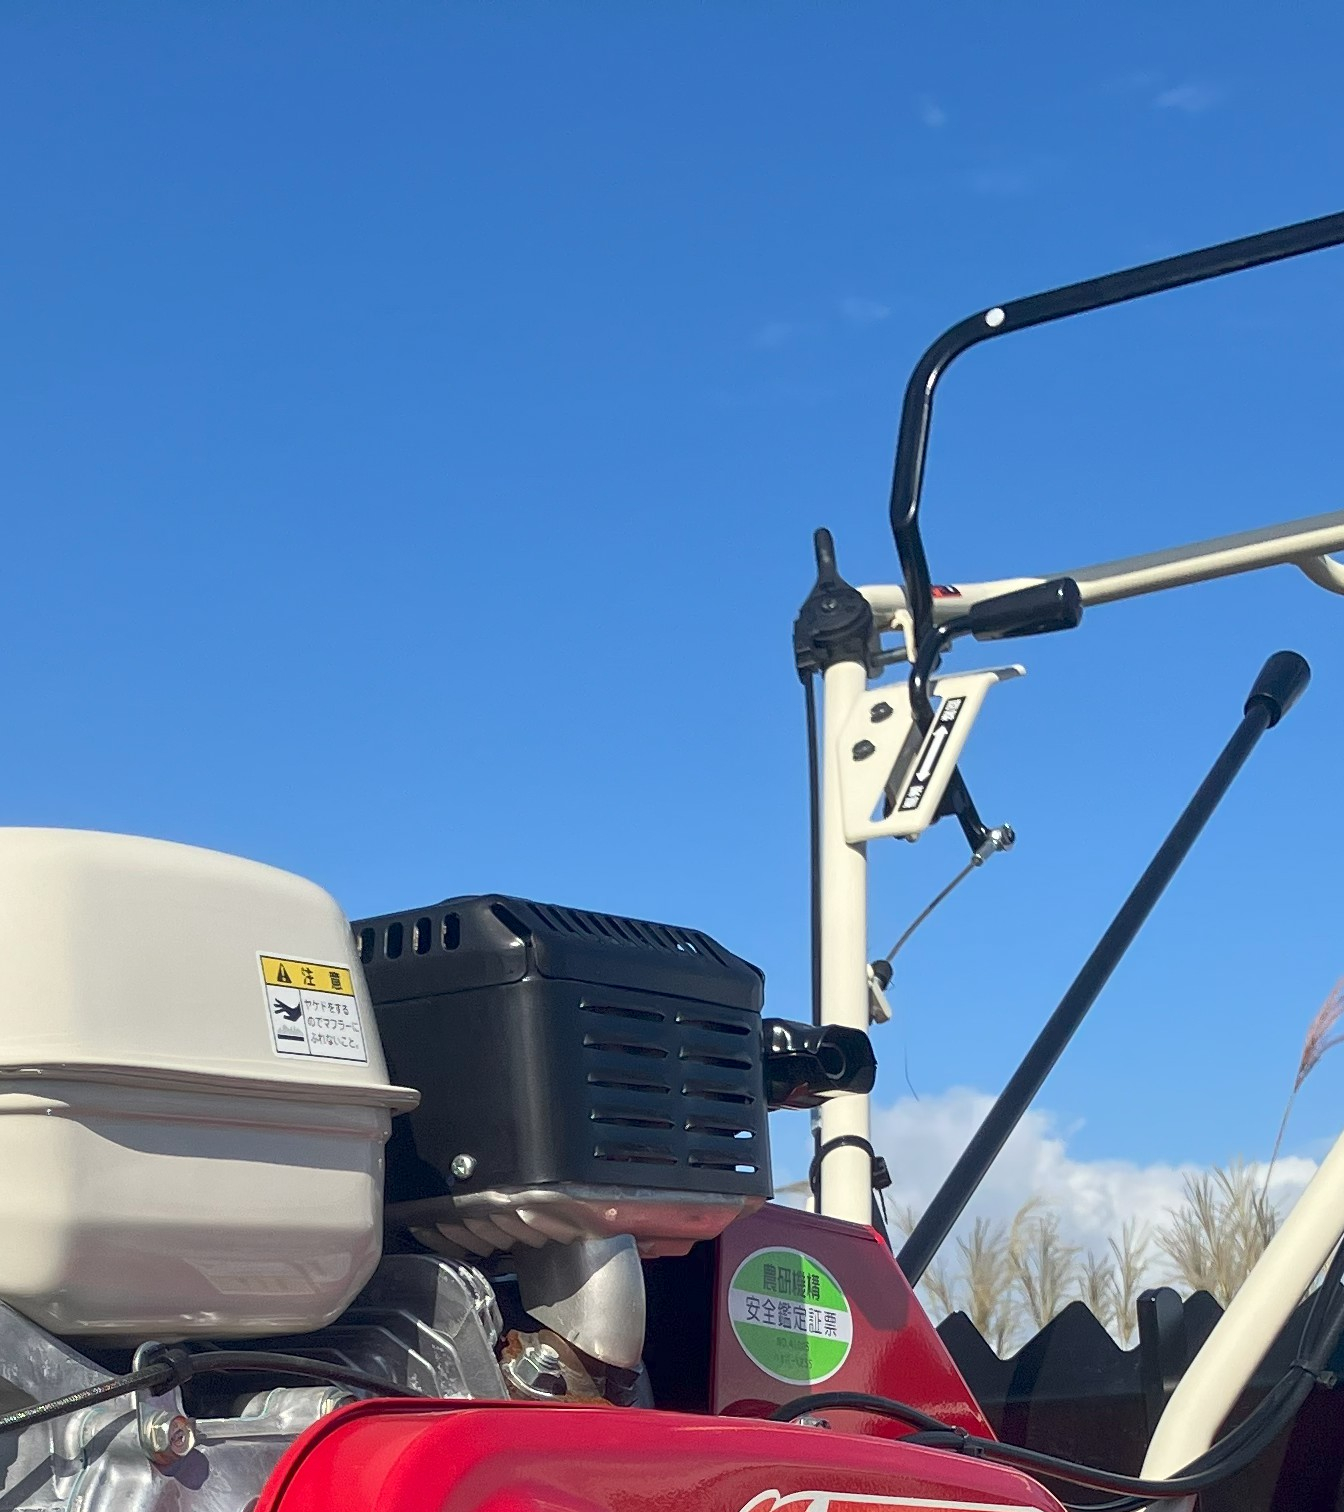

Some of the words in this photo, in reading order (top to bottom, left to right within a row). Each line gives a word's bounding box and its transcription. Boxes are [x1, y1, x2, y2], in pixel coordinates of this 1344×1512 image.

[301, 966, 343, 990] 注意
[304, 999, 349, 1016] ヤケドをする
[763, 1263, 821, 1302] 農研機構
[746, 1295, 837, 1337] 安全鑑定証票
